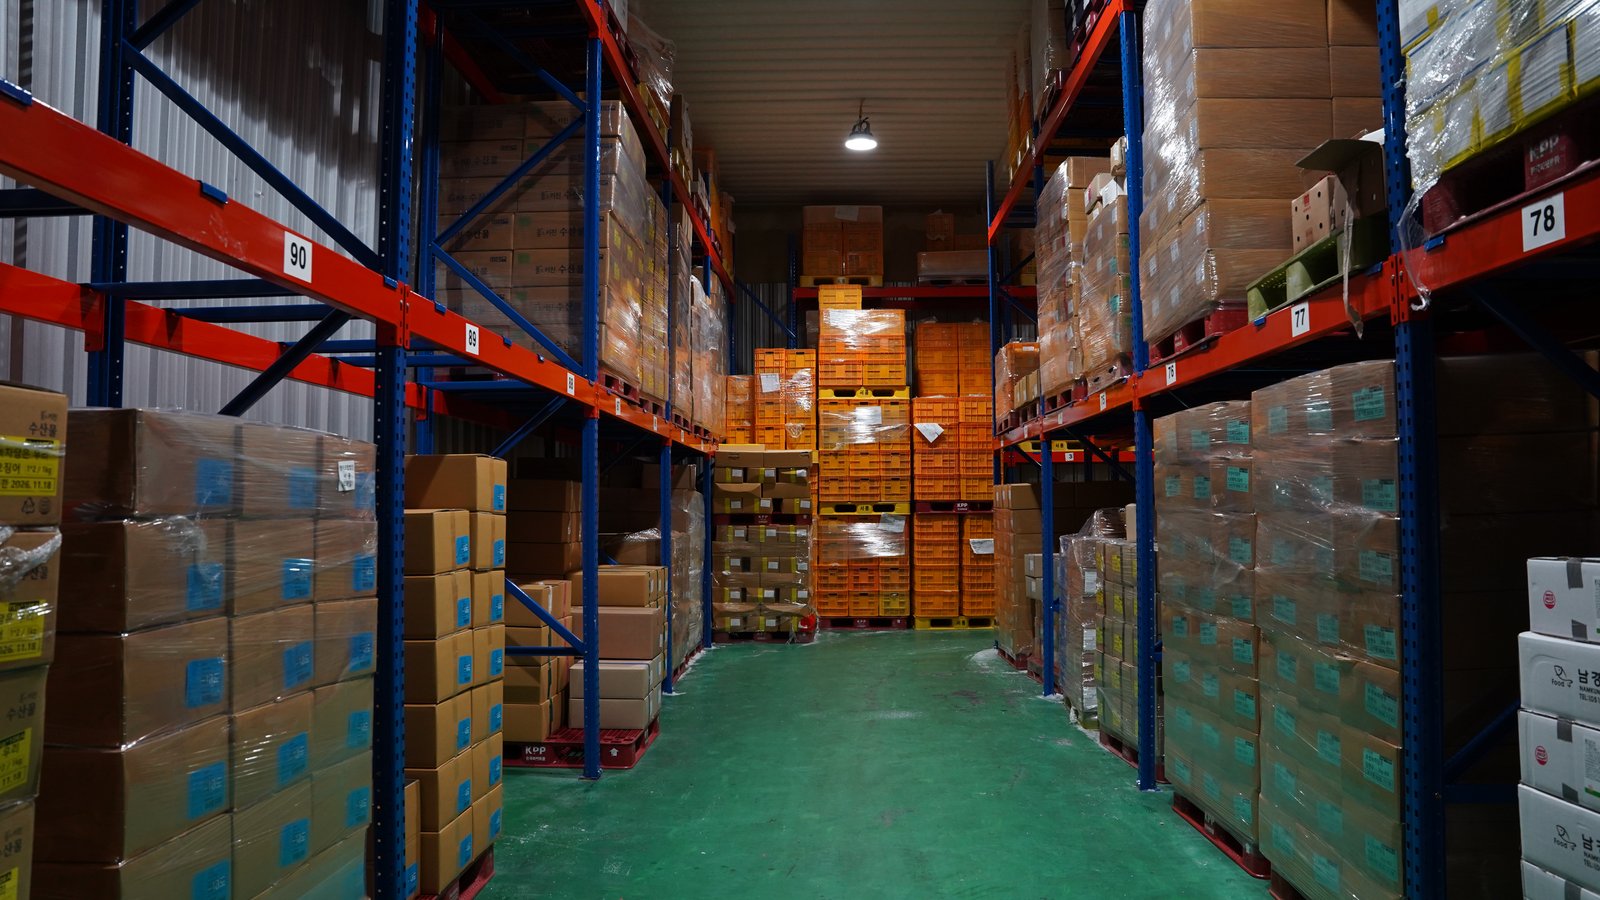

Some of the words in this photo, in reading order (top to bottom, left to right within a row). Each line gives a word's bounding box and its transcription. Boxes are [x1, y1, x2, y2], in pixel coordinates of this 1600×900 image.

[1530, 204, 1556, 236] 78
[290, 242, 306, 269] 90
[1294, 308, 1306, 328] 77
[468, 329, 477, 347] 89
[1167, 365, 1175, 379] 76
[29, 422, 57, 437] 수산물
[7, 702, 36, 721] 수산물
[525, 746, 546, 755] KPP
[0, 839, 22, 858] 산물
